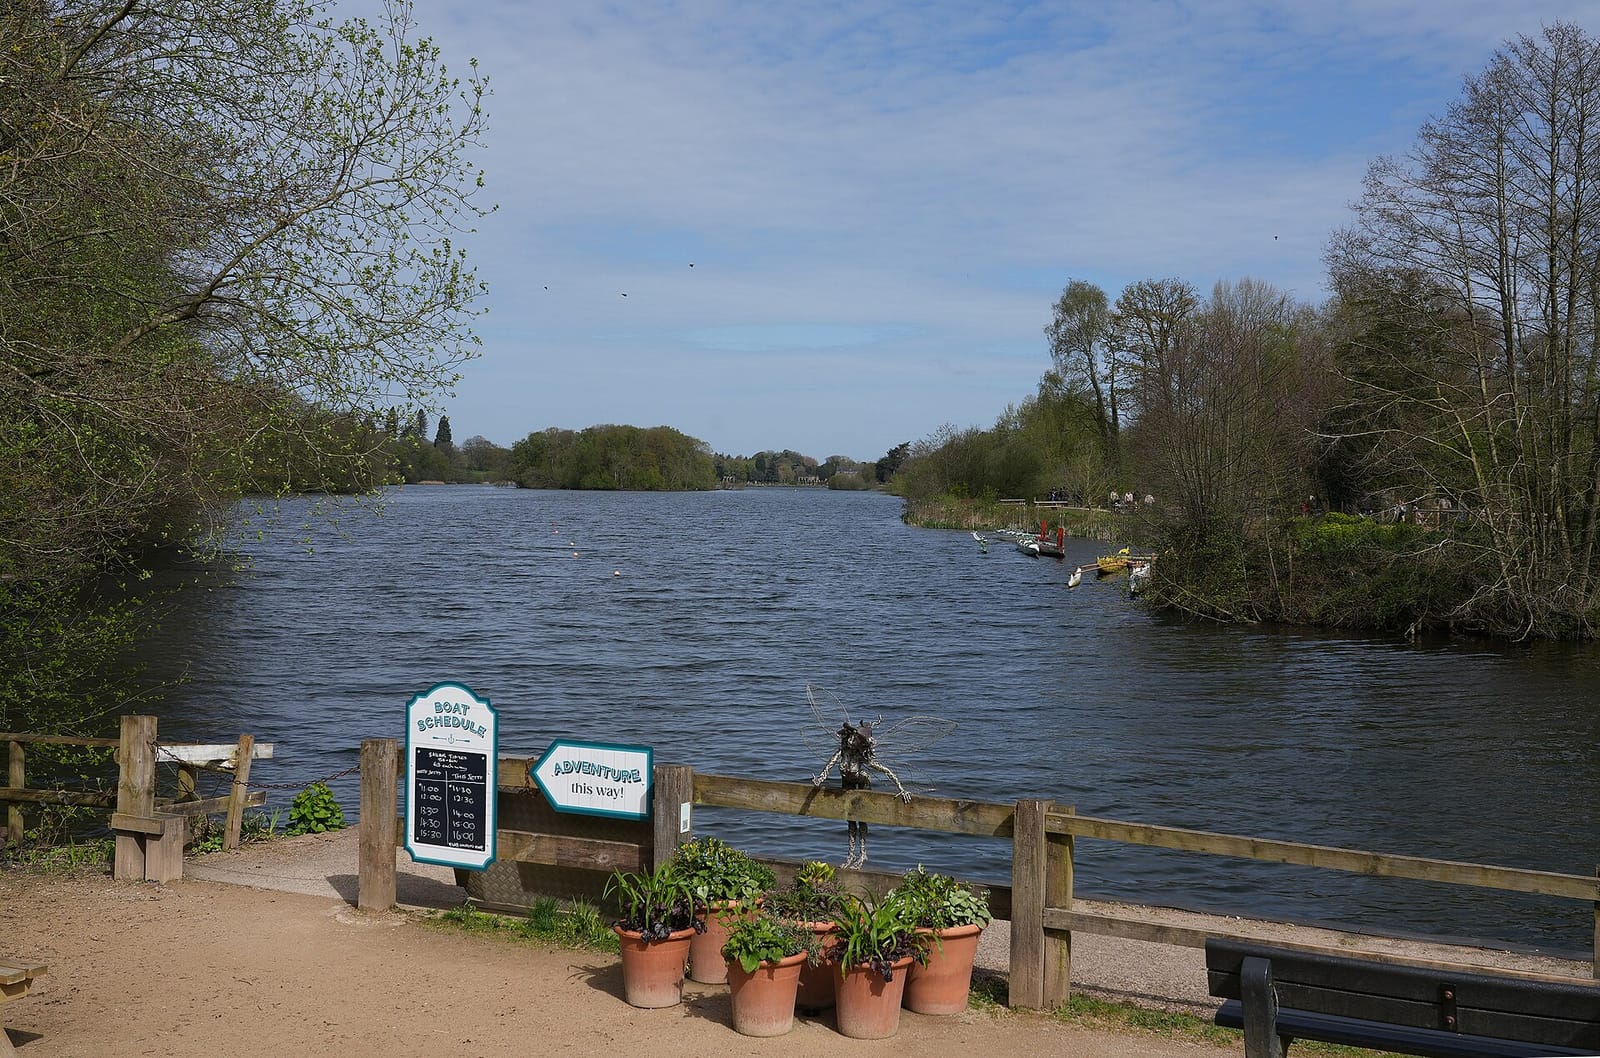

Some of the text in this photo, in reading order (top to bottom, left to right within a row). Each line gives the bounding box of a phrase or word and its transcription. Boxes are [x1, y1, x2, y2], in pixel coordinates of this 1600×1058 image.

[434, 701, 470, 716] BOAT
[417, 715, 487, 739] SCHEDULE
[553, 760, 642, 783] ADVENTURE
[571, 782, 624, 800] this way!
[420, 829, 442, 839] 15:30
